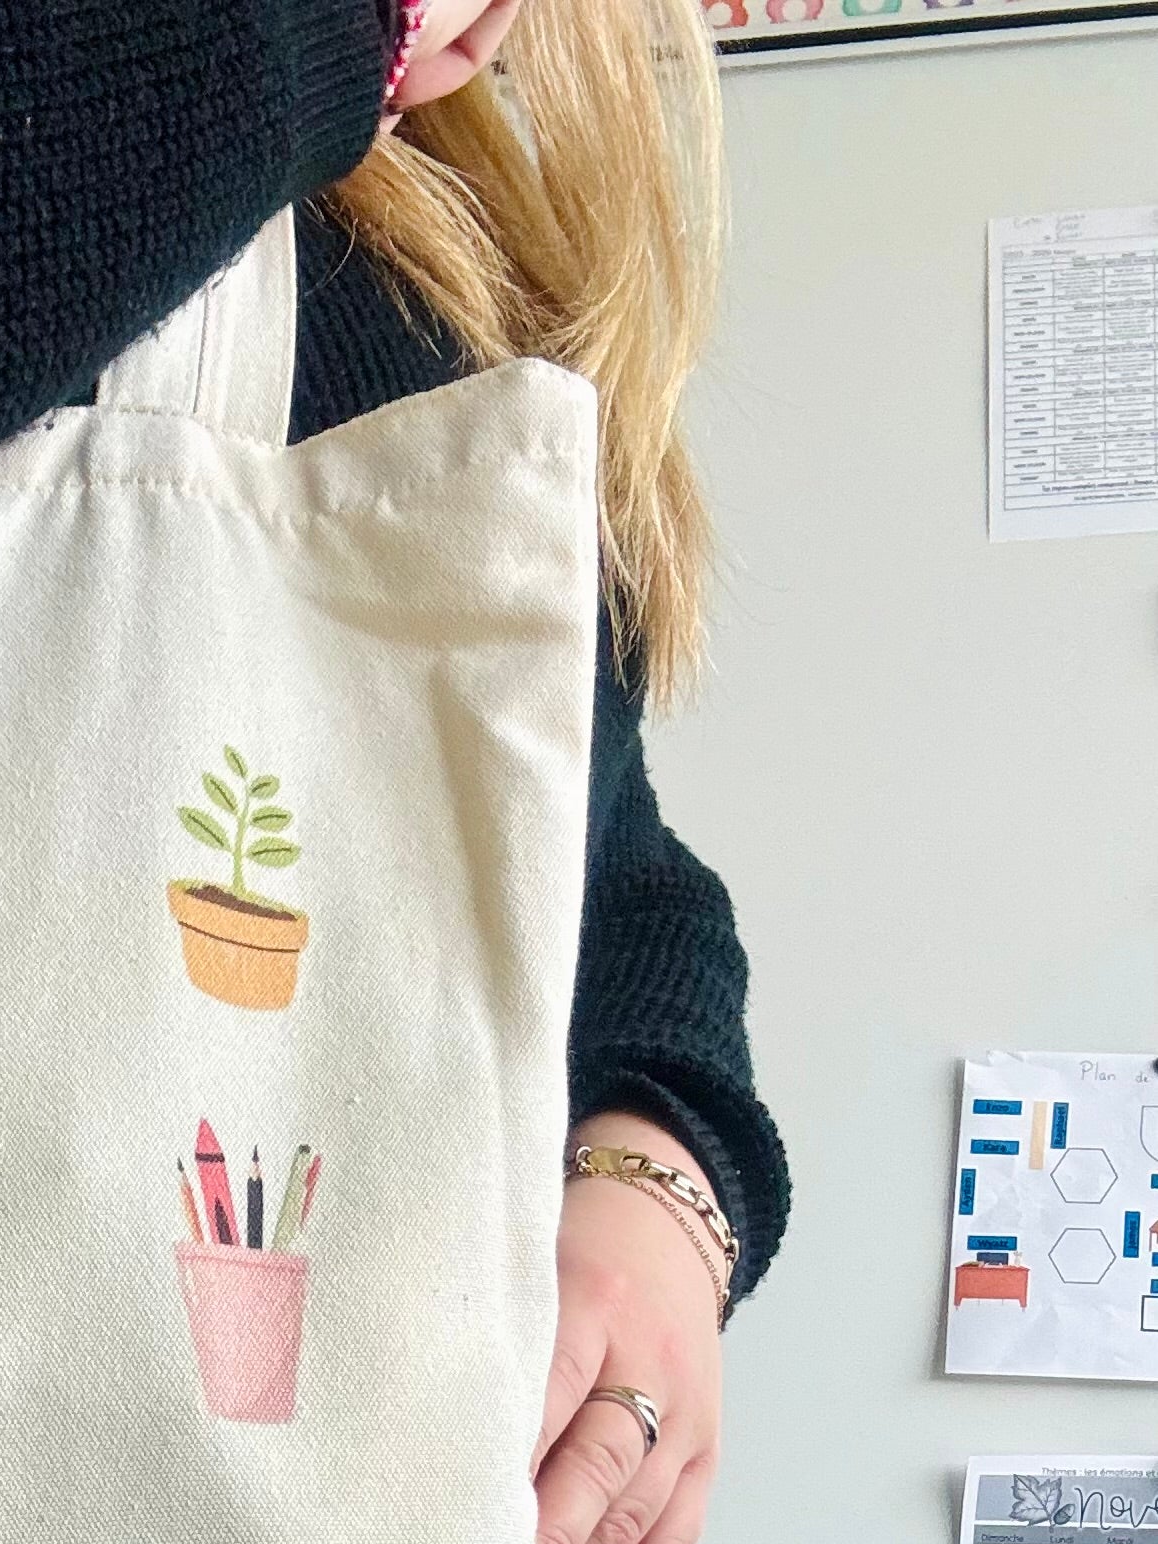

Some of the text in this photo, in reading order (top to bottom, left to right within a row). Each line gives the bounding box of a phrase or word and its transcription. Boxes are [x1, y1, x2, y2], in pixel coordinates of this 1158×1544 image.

[1079, 1059, 1117, 1081] Plan
[1074, 1487, 1158, 1531] Nov
[981, 1533, 1025, 1544] Dimanche
[1049, 1535, 1075, 1544] Lundi
